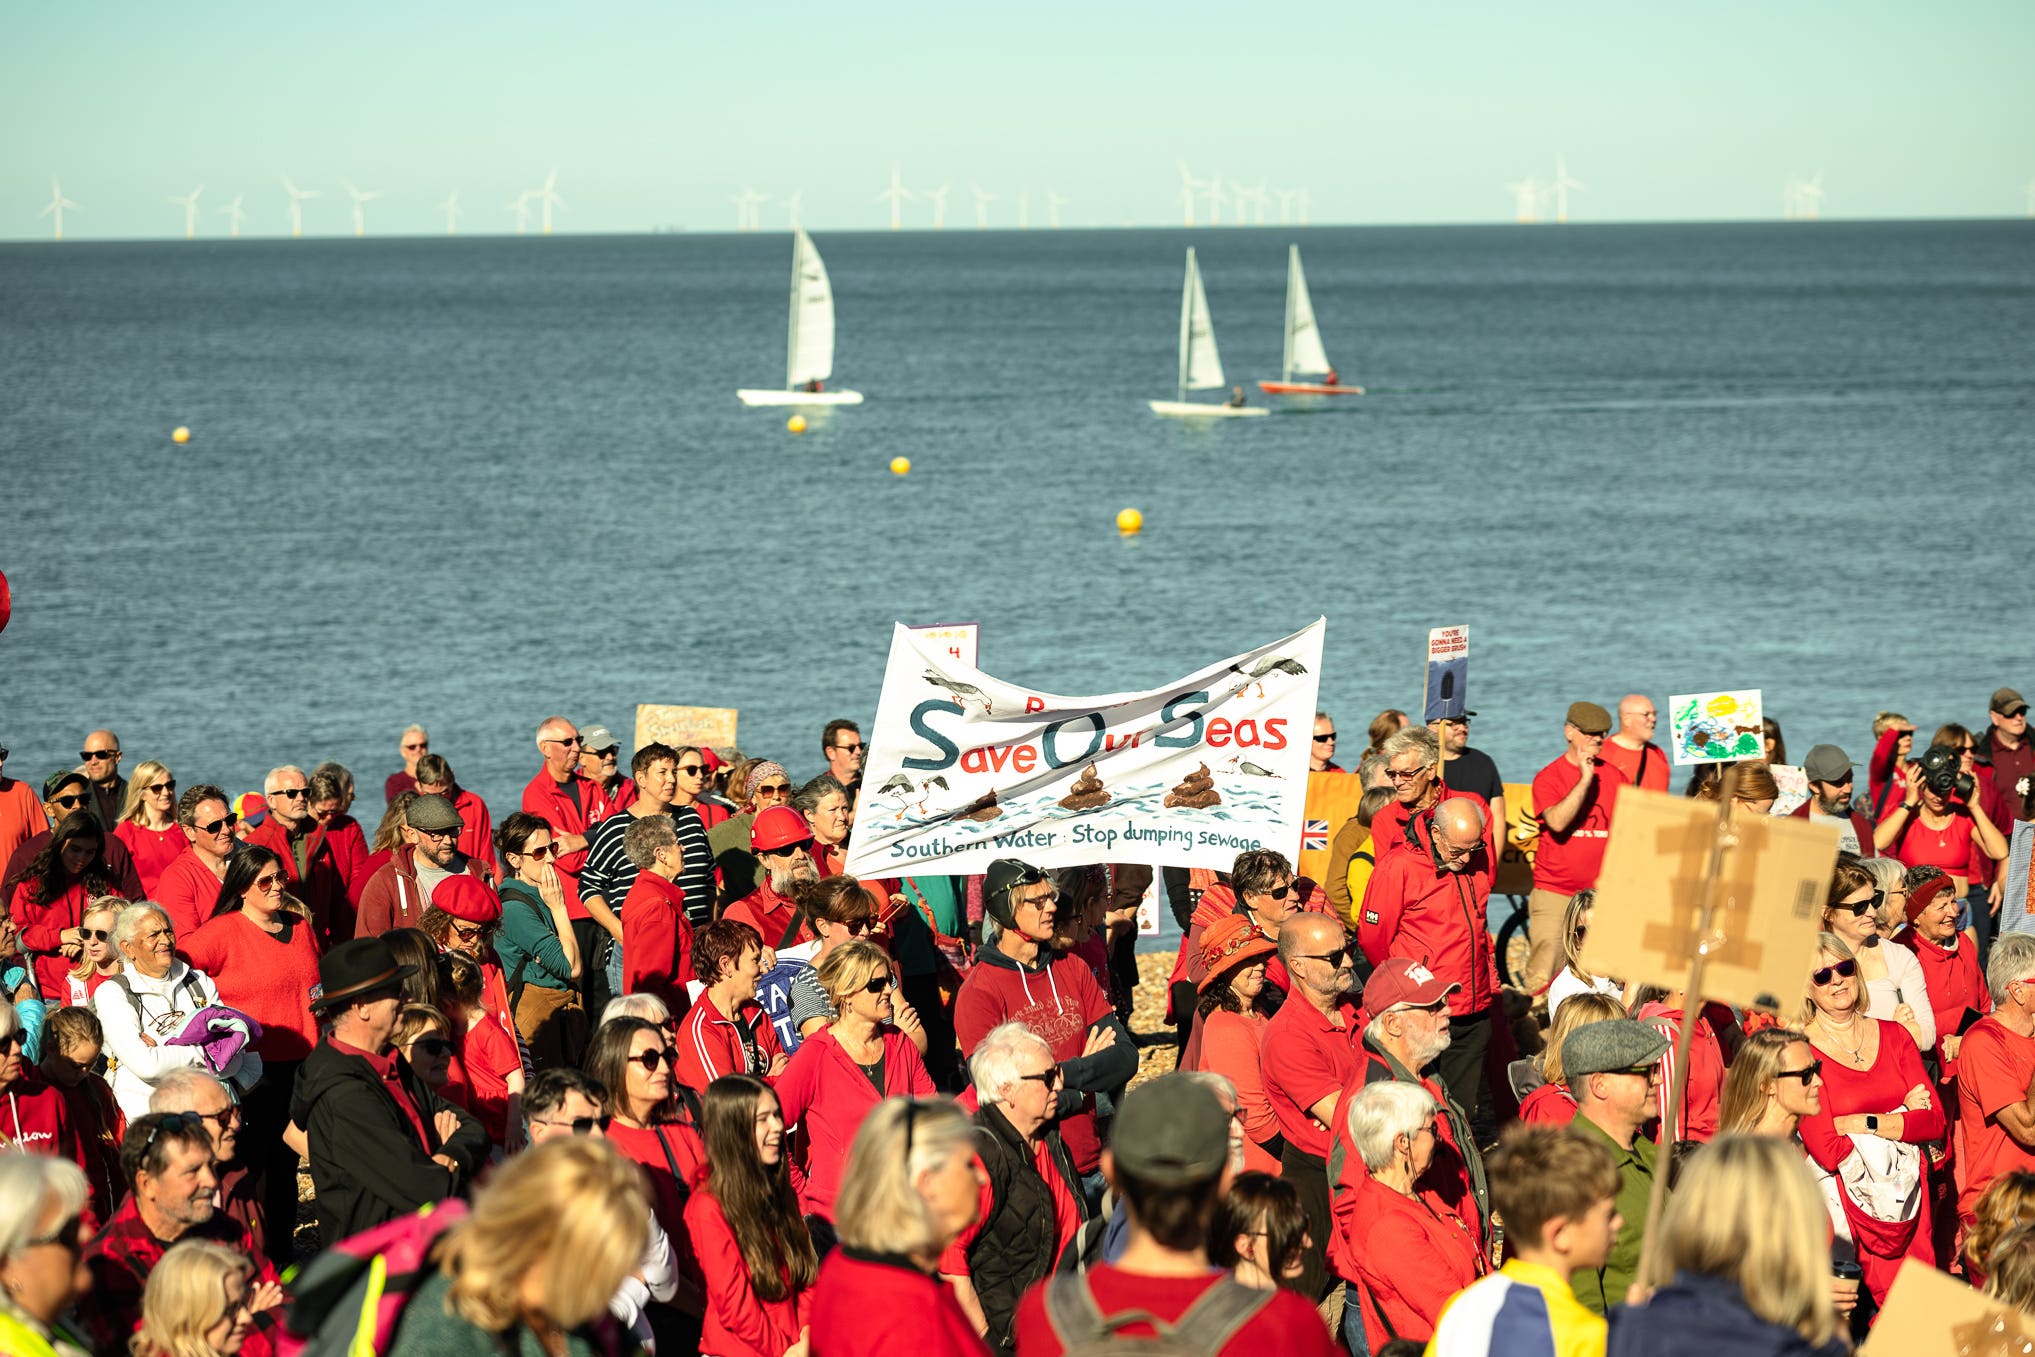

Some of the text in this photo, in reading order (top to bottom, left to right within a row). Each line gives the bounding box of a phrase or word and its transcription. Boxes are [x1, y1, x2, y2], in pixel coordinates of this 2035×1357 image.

[902, 691, 1288, 774] Save Our Seas
[890, 837, 987, 858] Southern
[992, 830, 1057, 848] Water
[1072, 823, 1118, 850] Stop
[1123, 820, 1193, 851] dumping
[1198, 830, 1262, 851] sewage
